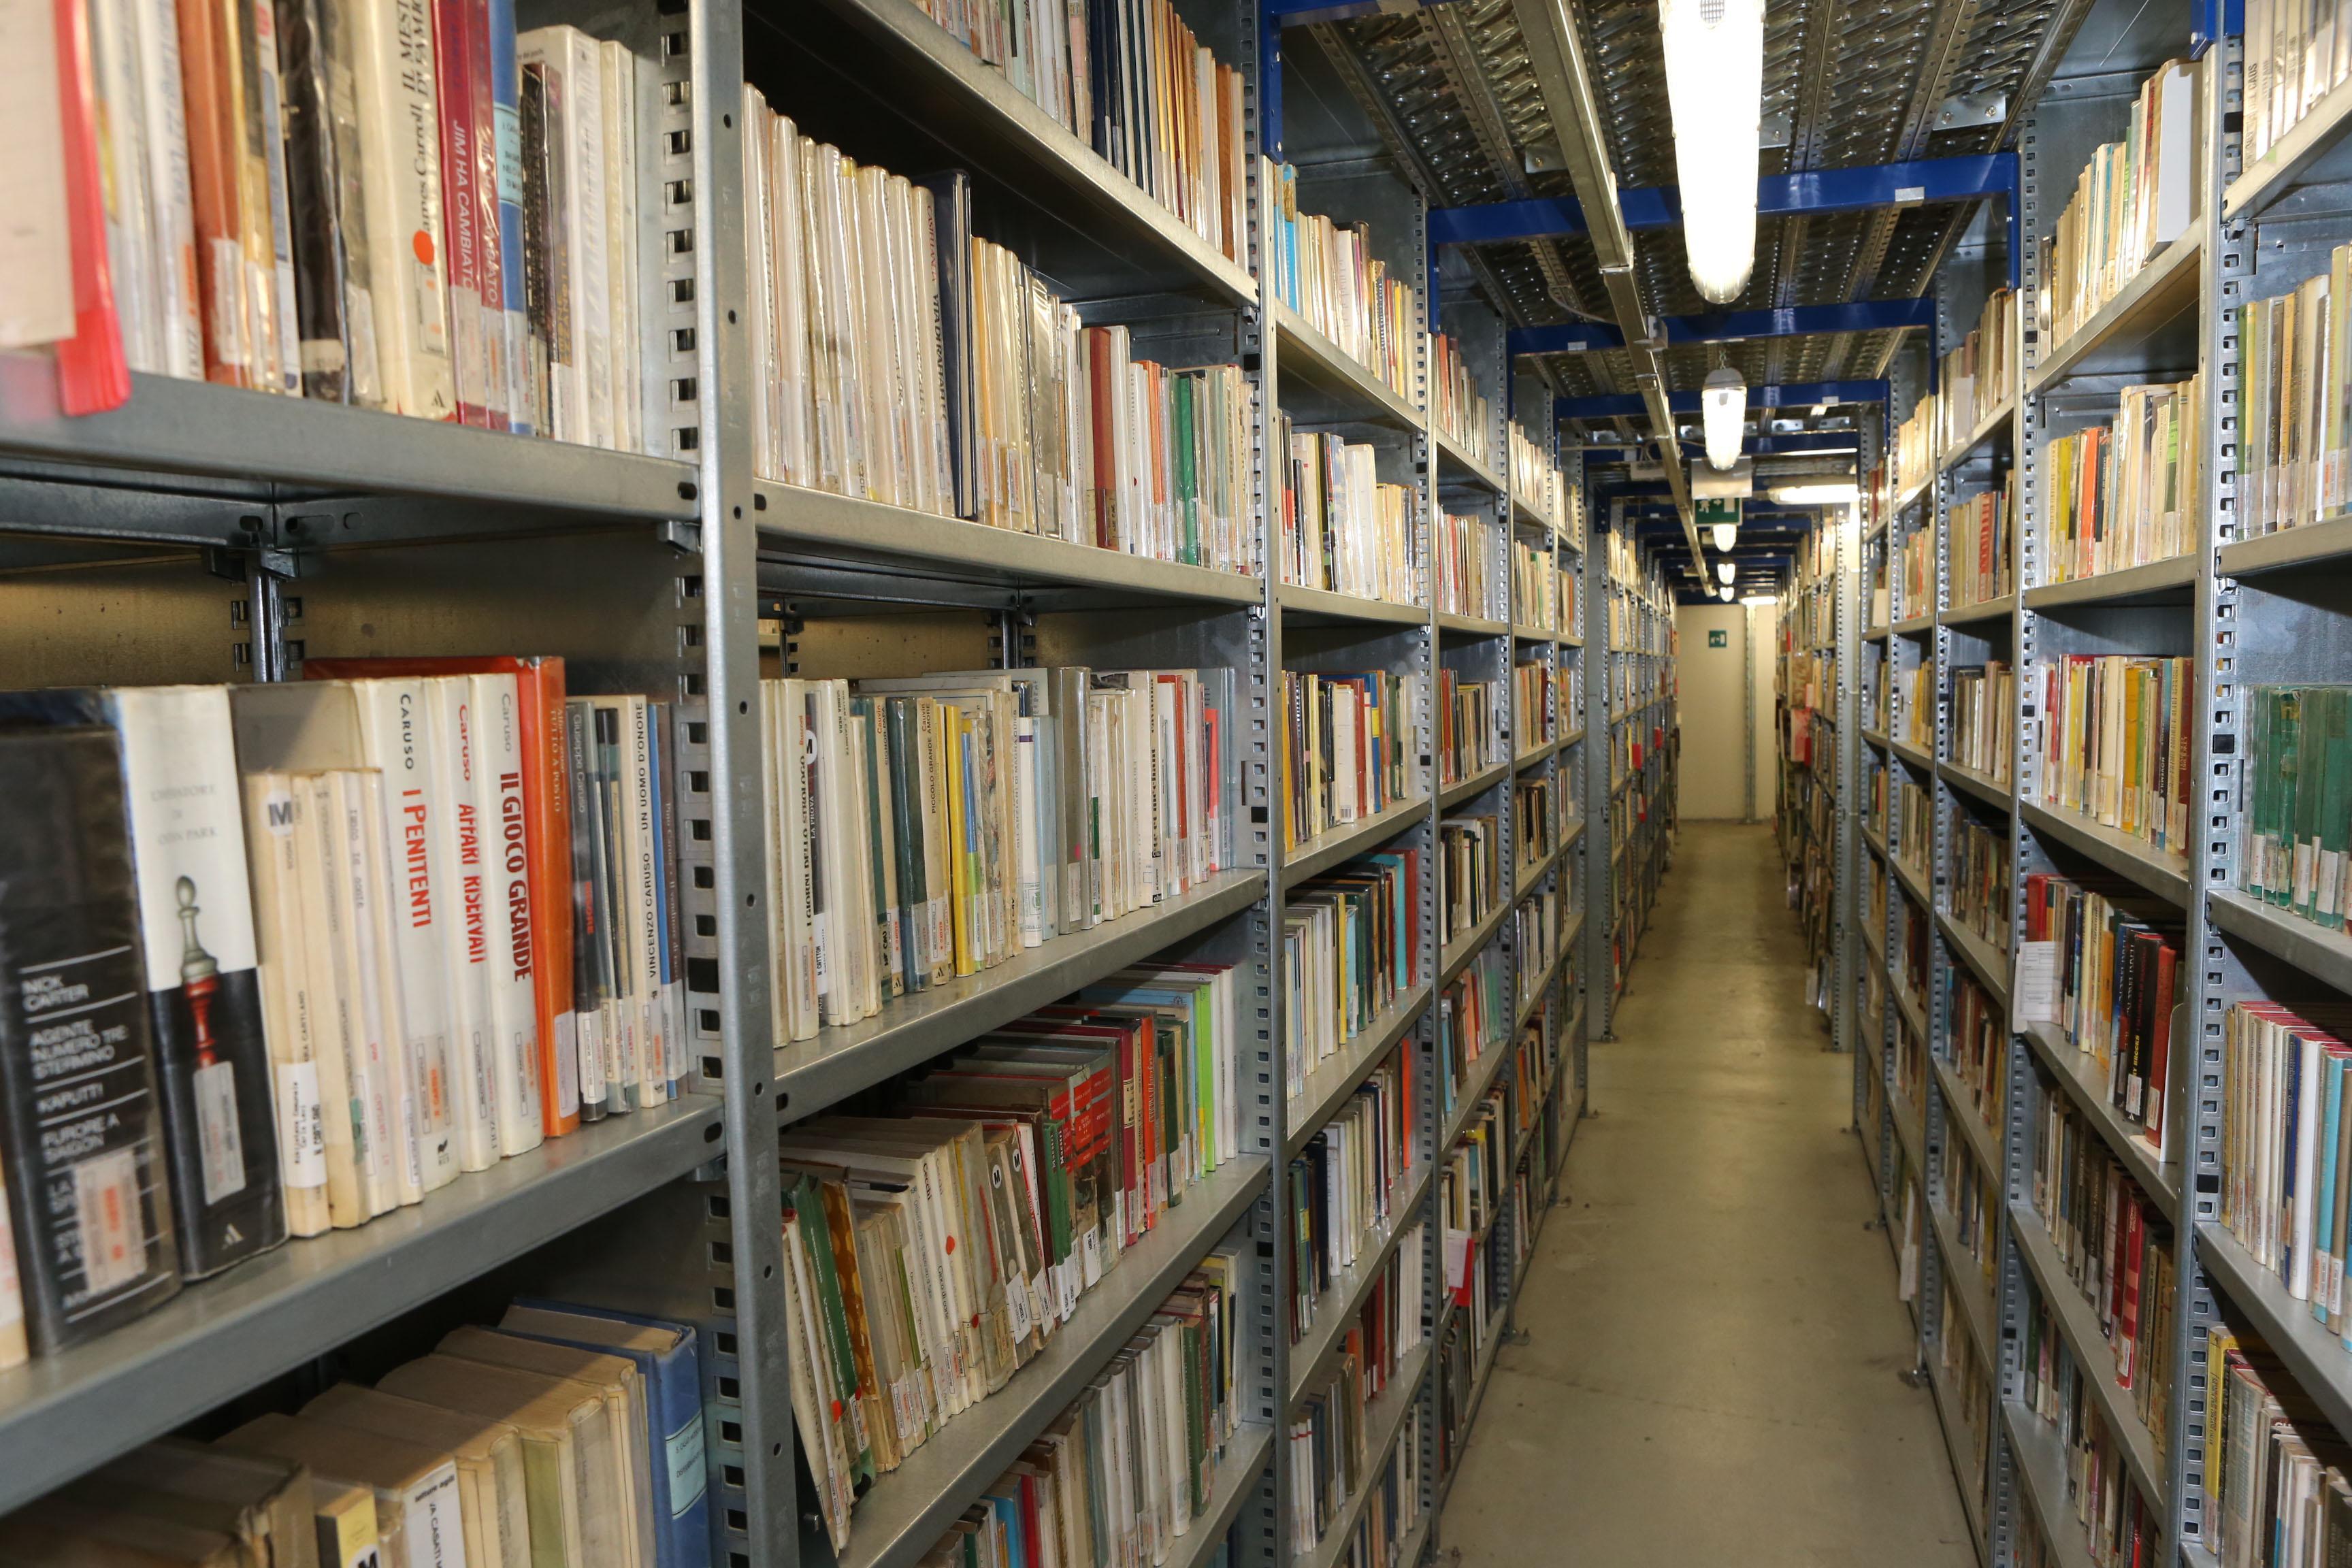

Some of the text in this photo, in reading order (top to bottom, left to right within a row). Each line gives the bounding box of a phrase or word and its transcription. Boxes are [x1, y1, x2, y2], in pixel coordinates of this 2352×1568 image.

[402, 68, 416, 91] IL
[409, 102, 431, 235] ames Carroll
[452, 118, 474, 291] JIM HA CAMBIATO
[399, 693, 414, 770] CARUSO
[501, 693, 512, 752] Caruso
[458, 704, 471, 782] Caruso
[573, 713, 587, 813] Giuseppe Caruso
[926, 739, 934, 772] GRANDE
[799, 755, 808, 824] STROLOGO
[928, 774, 936, 814] PICCOLO
[267, 801, 293, 827] M
[402, 788, 432, 929] I PENITENTI
[635, 702, 657, 979] VINCENZO CARUSO UN UOMO D'ONORE
[457, 802, 487, 964] AFFARI RISERVATI
[500, 772, 532, 983] IL GIOCO GRANDE
[804, 872, 813, 919] GIORNI
[22, 973, 63, 996] NICK
[23, 984, 89, 1012] CARTER
[30, 1019, 95, 1047] AGENTE
[31, 1024, 129, 1064] NUMERO TRE
[2133, 1034, 2141, 1065] BROOKS
[106, 1112, 121, 1130] A
[993, 1169, 1000, 1185] M
[1014, 1153, 1021, 1166] M
[923, 1162, 931, 1201] Cecchi
[414, 1484, 438, 1503] letture
[431, 1517, 442, 1560] CASATI
